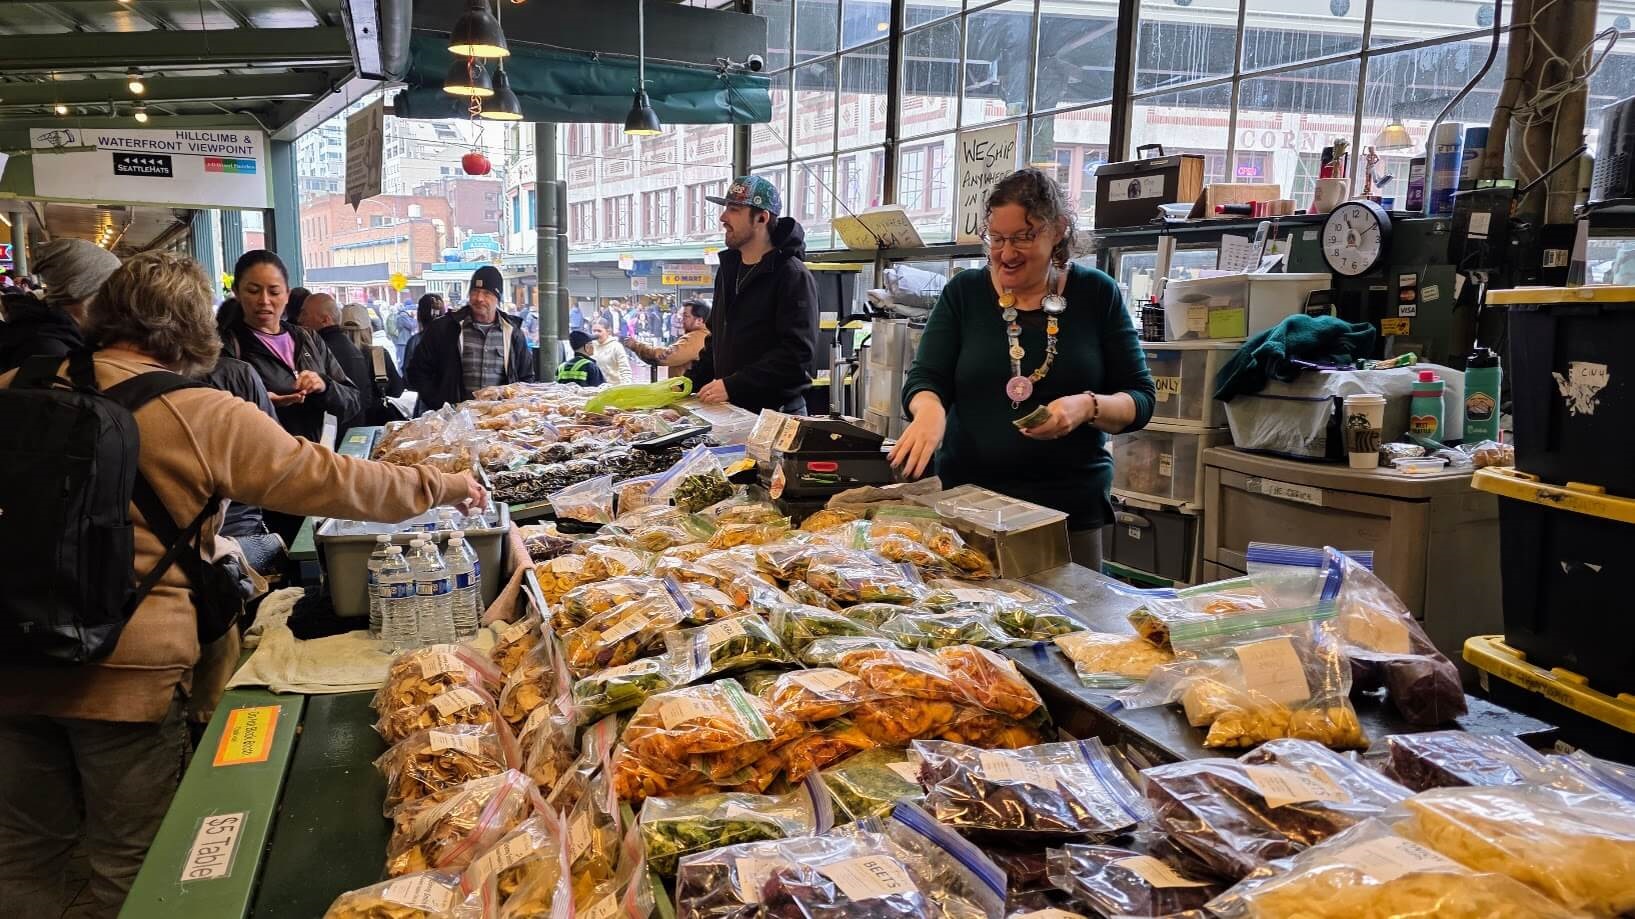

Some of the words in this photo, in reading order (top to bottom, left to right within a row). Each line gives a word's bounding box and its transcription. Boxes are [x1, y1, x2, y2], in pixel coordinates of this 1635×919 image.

[175, 130, 238, 143] HILLCLIMB
[244, 135, 251, 144] &
[1240, 130, 1352, 150] CORNE
[98, 136, 182, 151] WATERFRONT
[188, 143, 254, 155] VIEWPOINT
[1352, 209, 1360, 218] 12
[1351, 262, 1357, 270] 6
[1400, 306, 1416, 314] VISA
[1155, 378, 1179, 393] ONLY
[206, 817, 240, 835] $5
[190, 836, 231, 877] Table
[863, 861, 901, 888] BEETS
